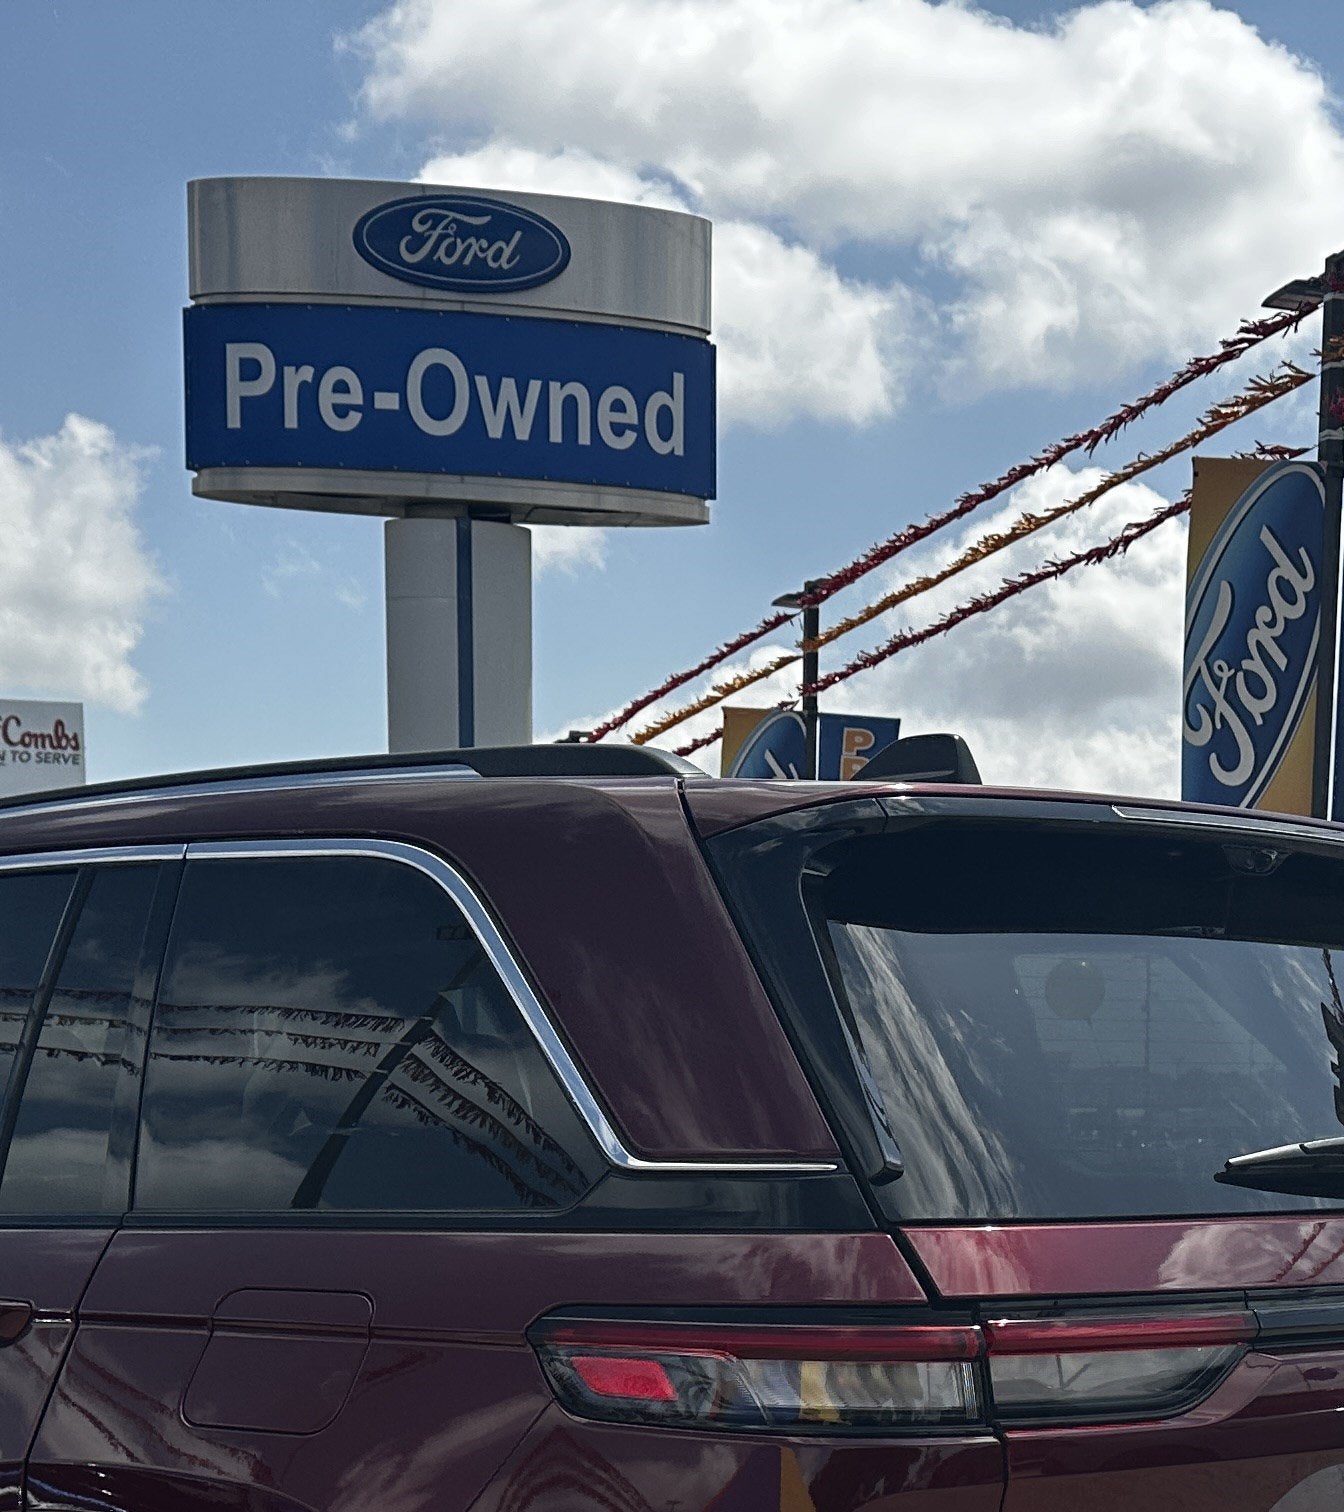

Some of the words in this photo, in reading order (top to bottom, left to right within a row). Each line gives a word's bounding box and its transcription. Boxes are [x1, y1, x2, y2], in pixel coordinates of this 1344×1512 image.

[399, 207, 523, 271] Ford
[225, 342, 685, 457] Pre-Owned
[1183, 524, 1316, 787] Ford
[11, 750, 32, 764] TO
[35, 751, 80, 766] SERVE
